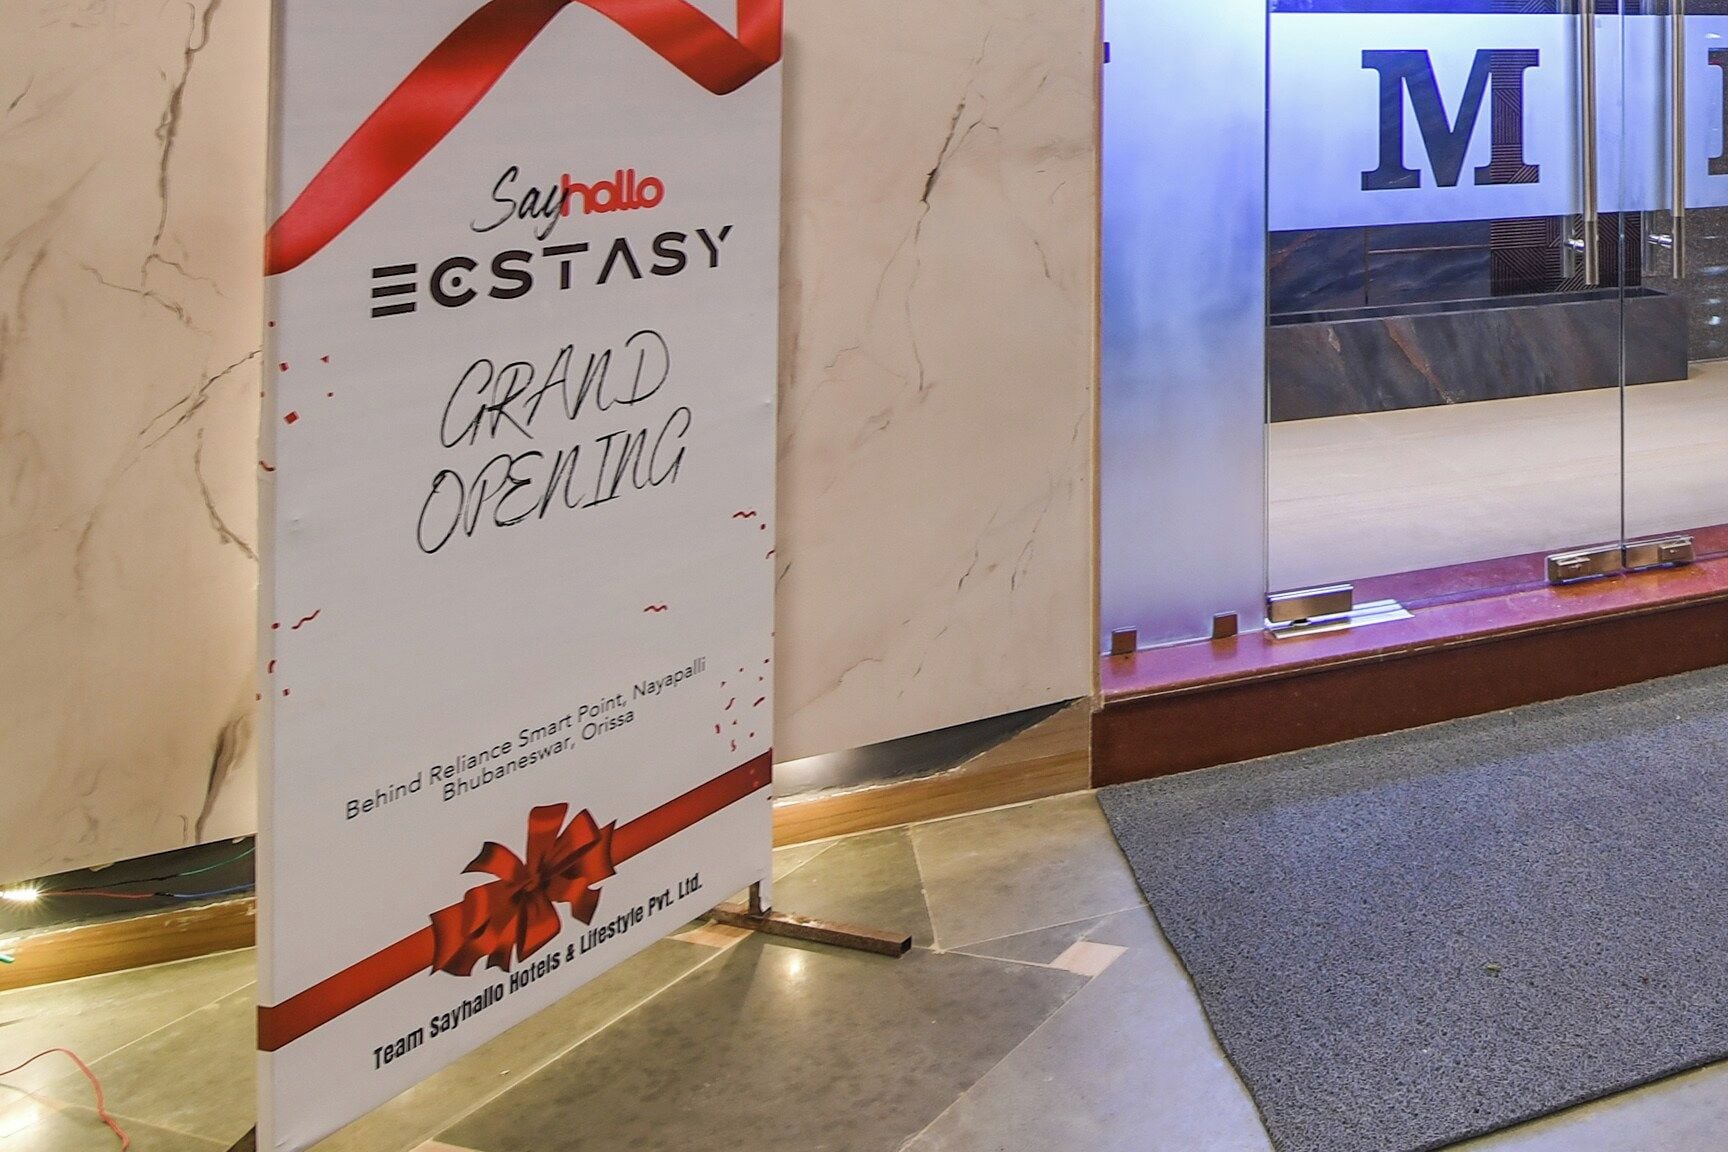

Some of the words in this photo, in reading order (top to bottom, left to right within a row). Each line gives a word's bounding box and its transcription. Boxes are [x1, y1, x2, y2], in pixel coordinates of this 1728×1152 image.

[1361, 49, 1540, 191] M
[470, 165, 665, 240] Sayhallo
[371, 224, 733, 319] ECSTASY
[440, 328, 670, 448] GRAND
[416, 406, 692, 554] OPENING
[346, 772, 422, 820] Behind
[429, 741, 512, 785] Reliance
[518, 714, 572, 748] Smart
[578, 694, 627, 723] Point,
[633, 656, 706, 699] Nayapalli
[443, 736, 576, 802] Bhubaneswar,
[581, 710, 634, 741] Orissa
[373, 1027, 424, 1070] Team
[430, 983, 504, 1038] Sayhallo
[509, 951, 561, 994] Hotels
[566, 943, 575, 962] &
[580, 905, 644, 955] Lifestyle
[648, 888, 675, 917] Pvt.
[678, 872, 702, 899] Ltd.
